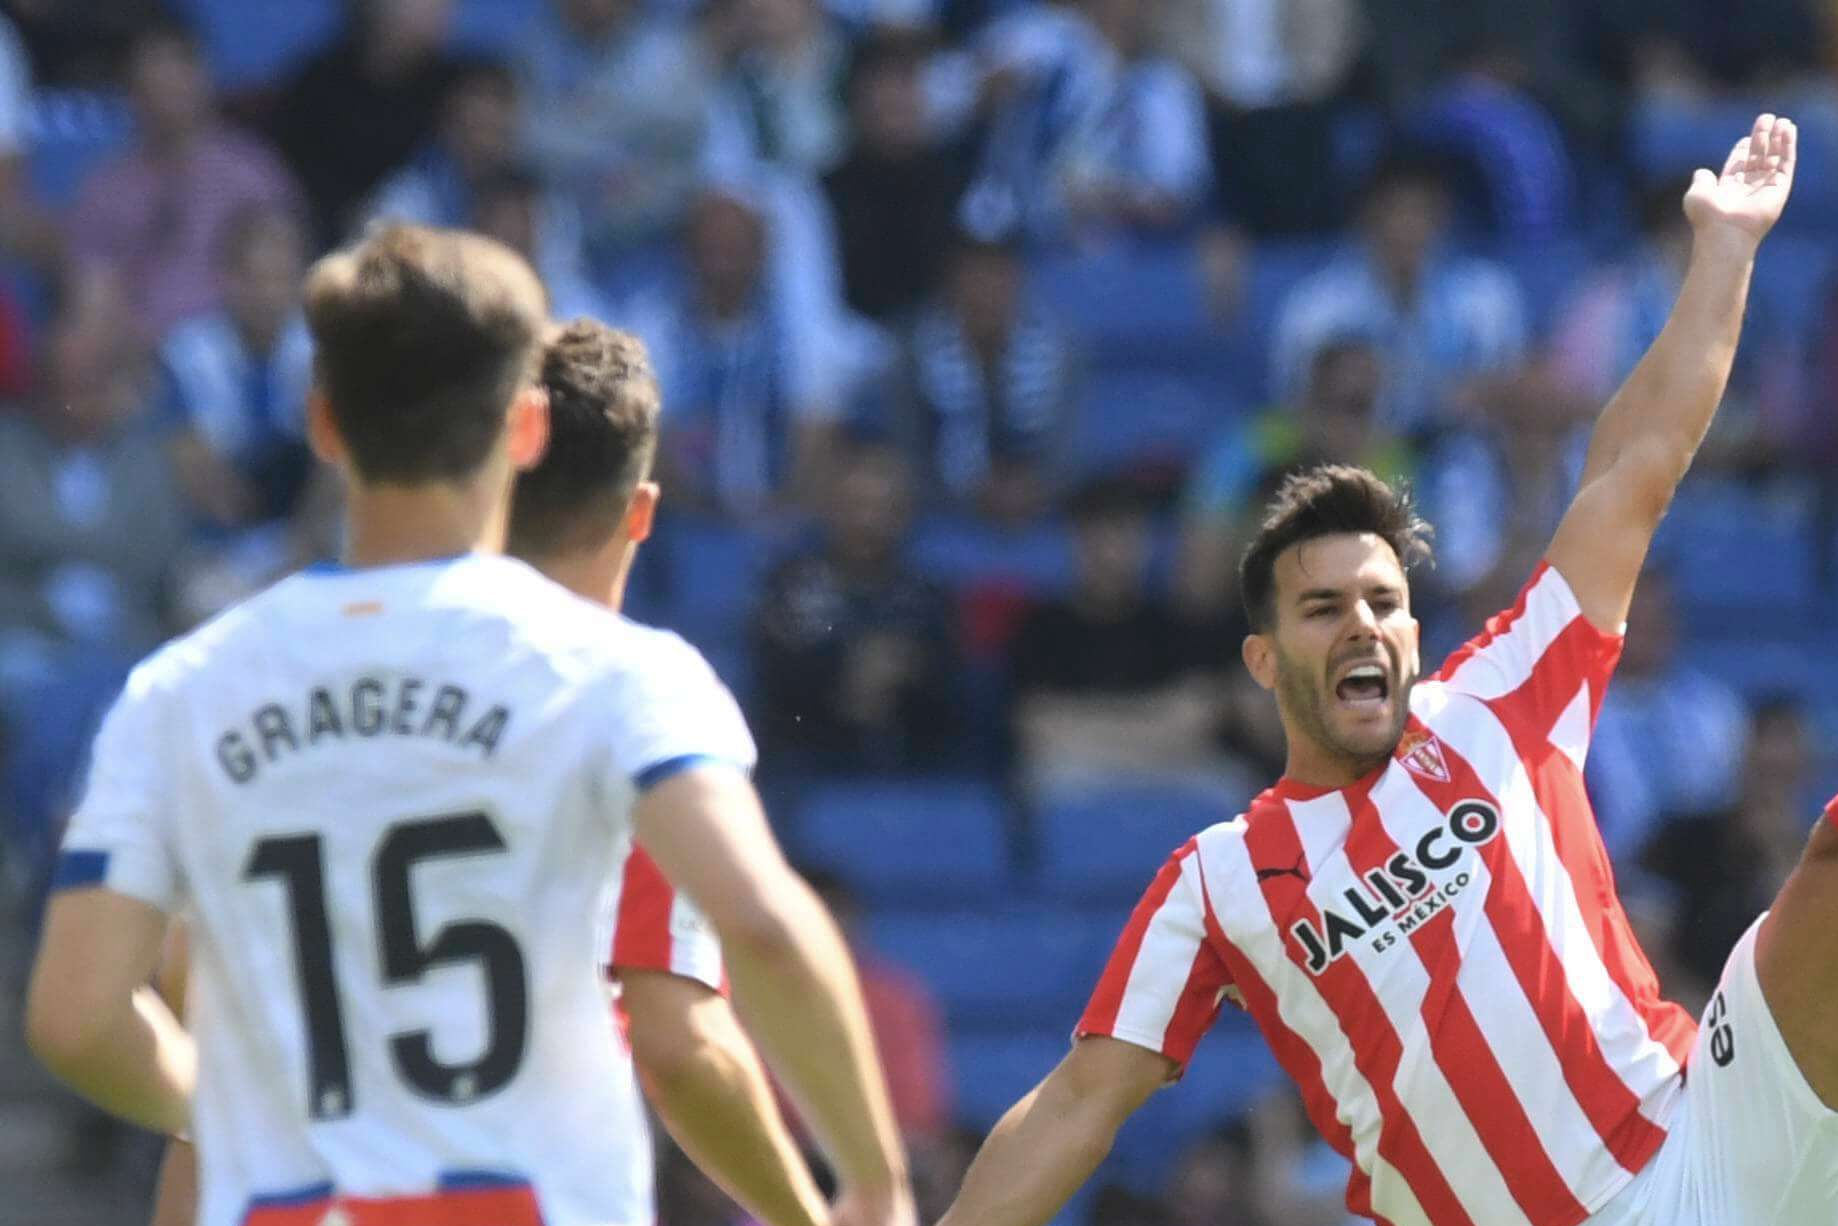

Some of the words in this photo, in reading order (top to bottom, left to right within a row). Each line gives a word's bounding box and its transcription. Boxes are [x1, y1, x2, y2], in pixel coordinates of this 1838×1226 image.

[216, 676, 510, 784] GRAGERA
[1293, 801, 1499, 973] JALISCO
[1371, 930, 1397, 954] ES
[241, 811, 530, 1121] 15
